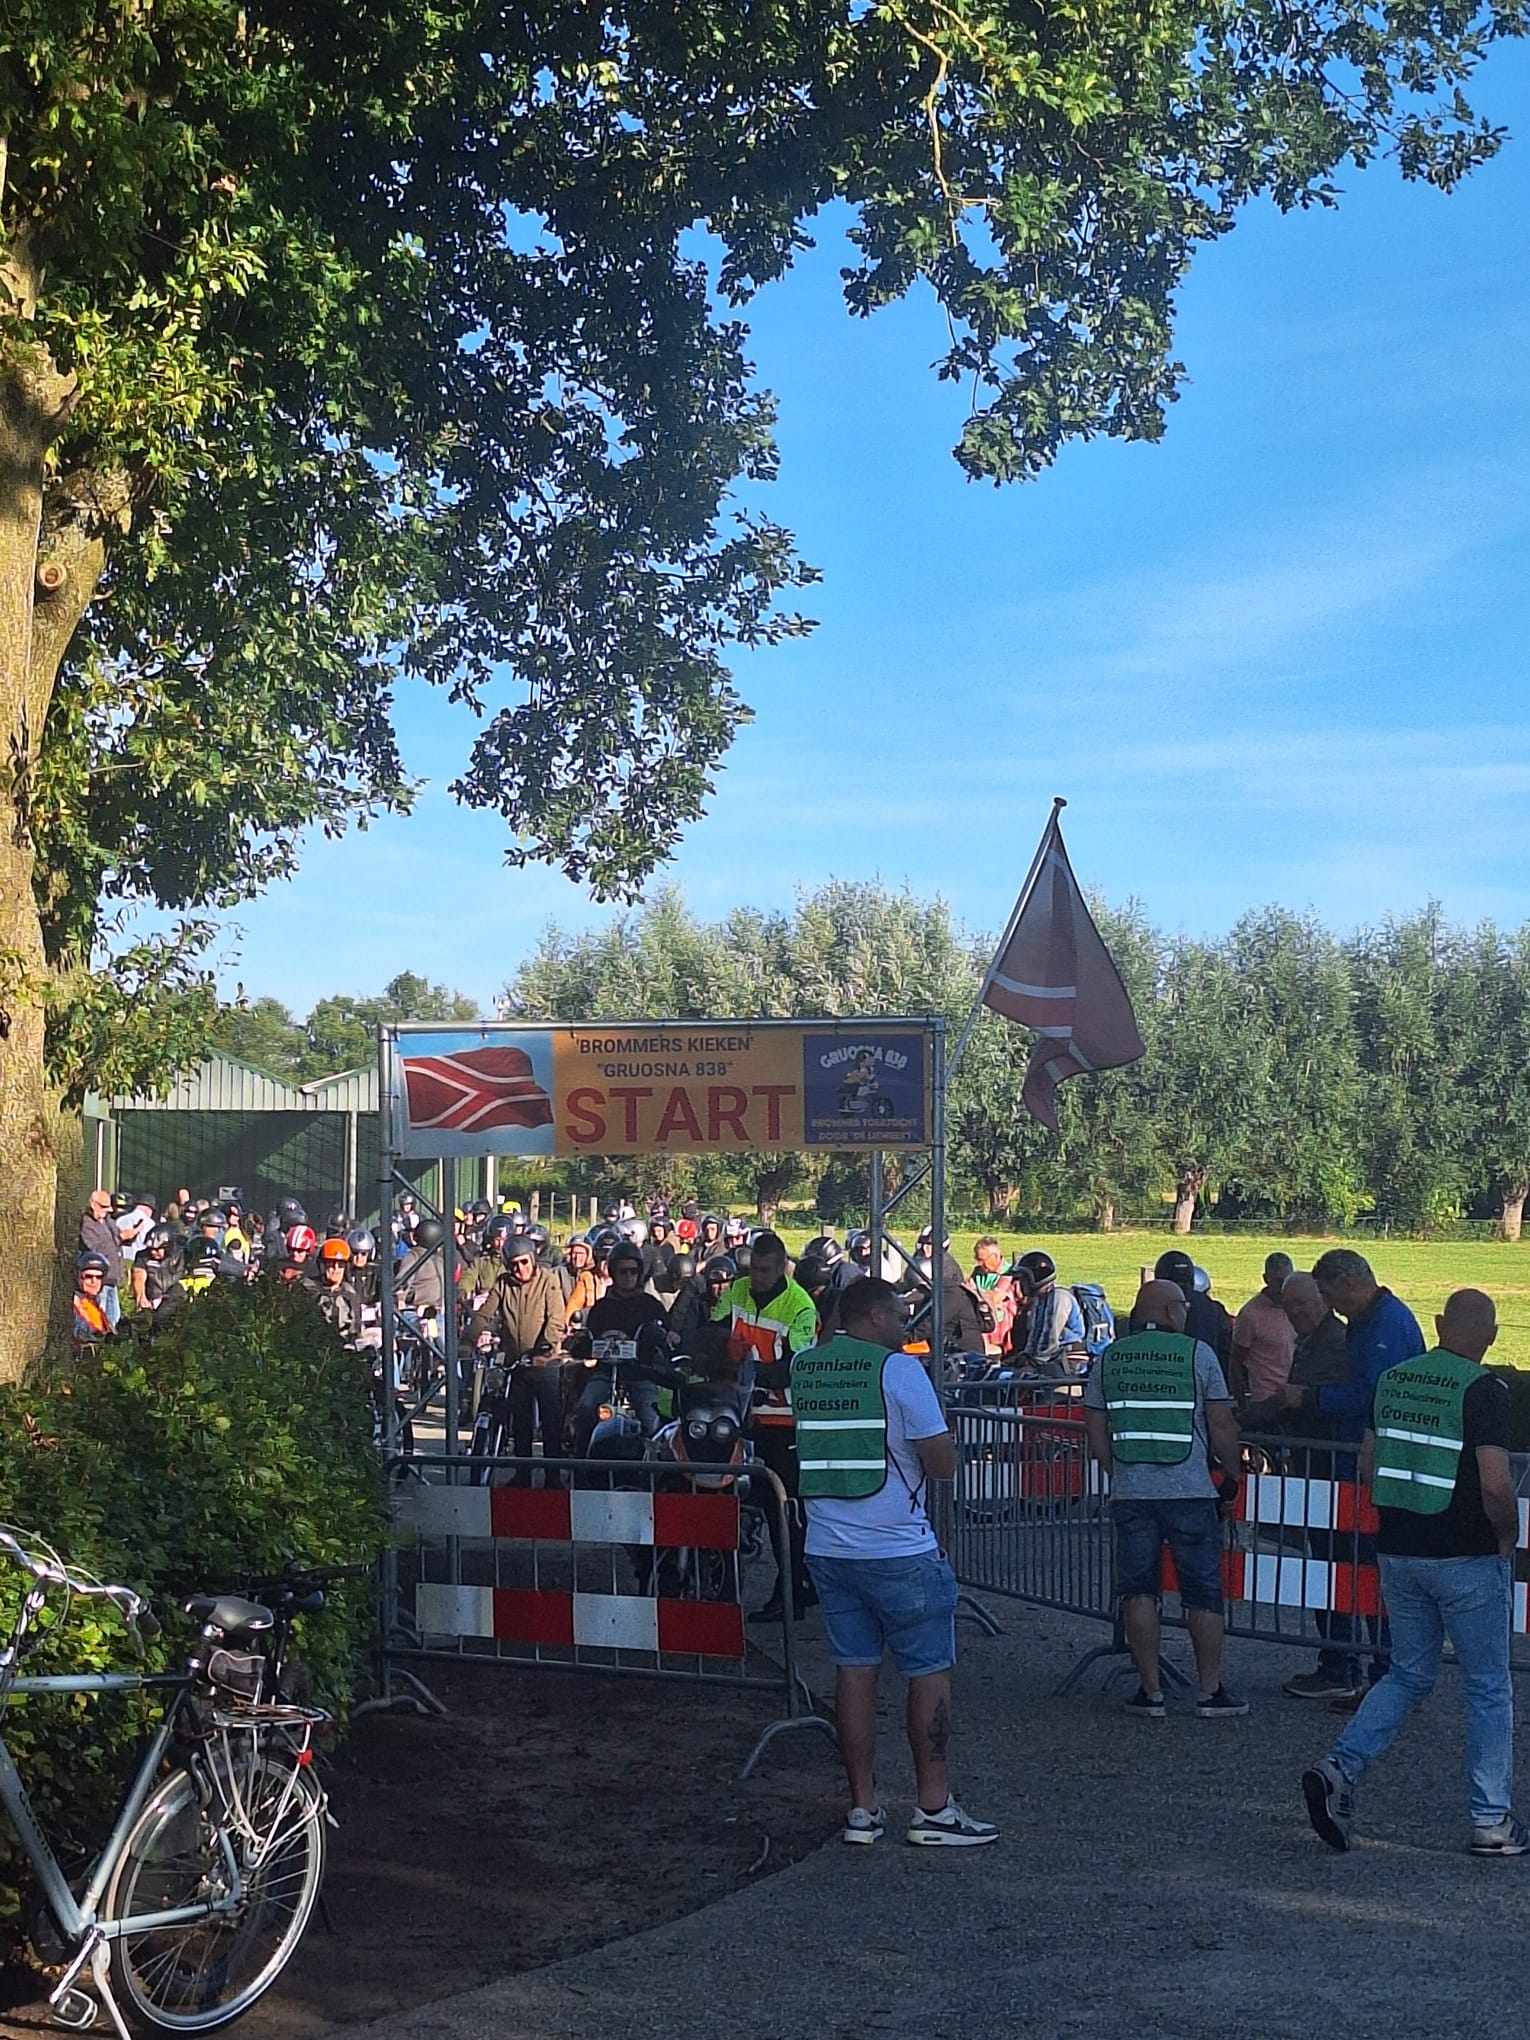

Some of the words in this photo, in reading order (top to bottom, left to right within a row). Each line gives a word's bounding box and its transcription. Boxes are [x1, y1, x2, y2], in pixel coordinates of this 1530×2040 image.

[820, 1045, 884, 1069] GRUOA
[565, 1085, 797, 1144] START
[796, 1357, 873, 1375] Organisatie
[1110, 1350, 1185, 1364] Organisatie
[1118, 1381, 1177, 1395] Groessen
[1386, 1369, 1461, 1390] Organisatie
[796, 1397, 860, 1411] Groessen
[1381, 1404, 1440, 1428] Groessen
